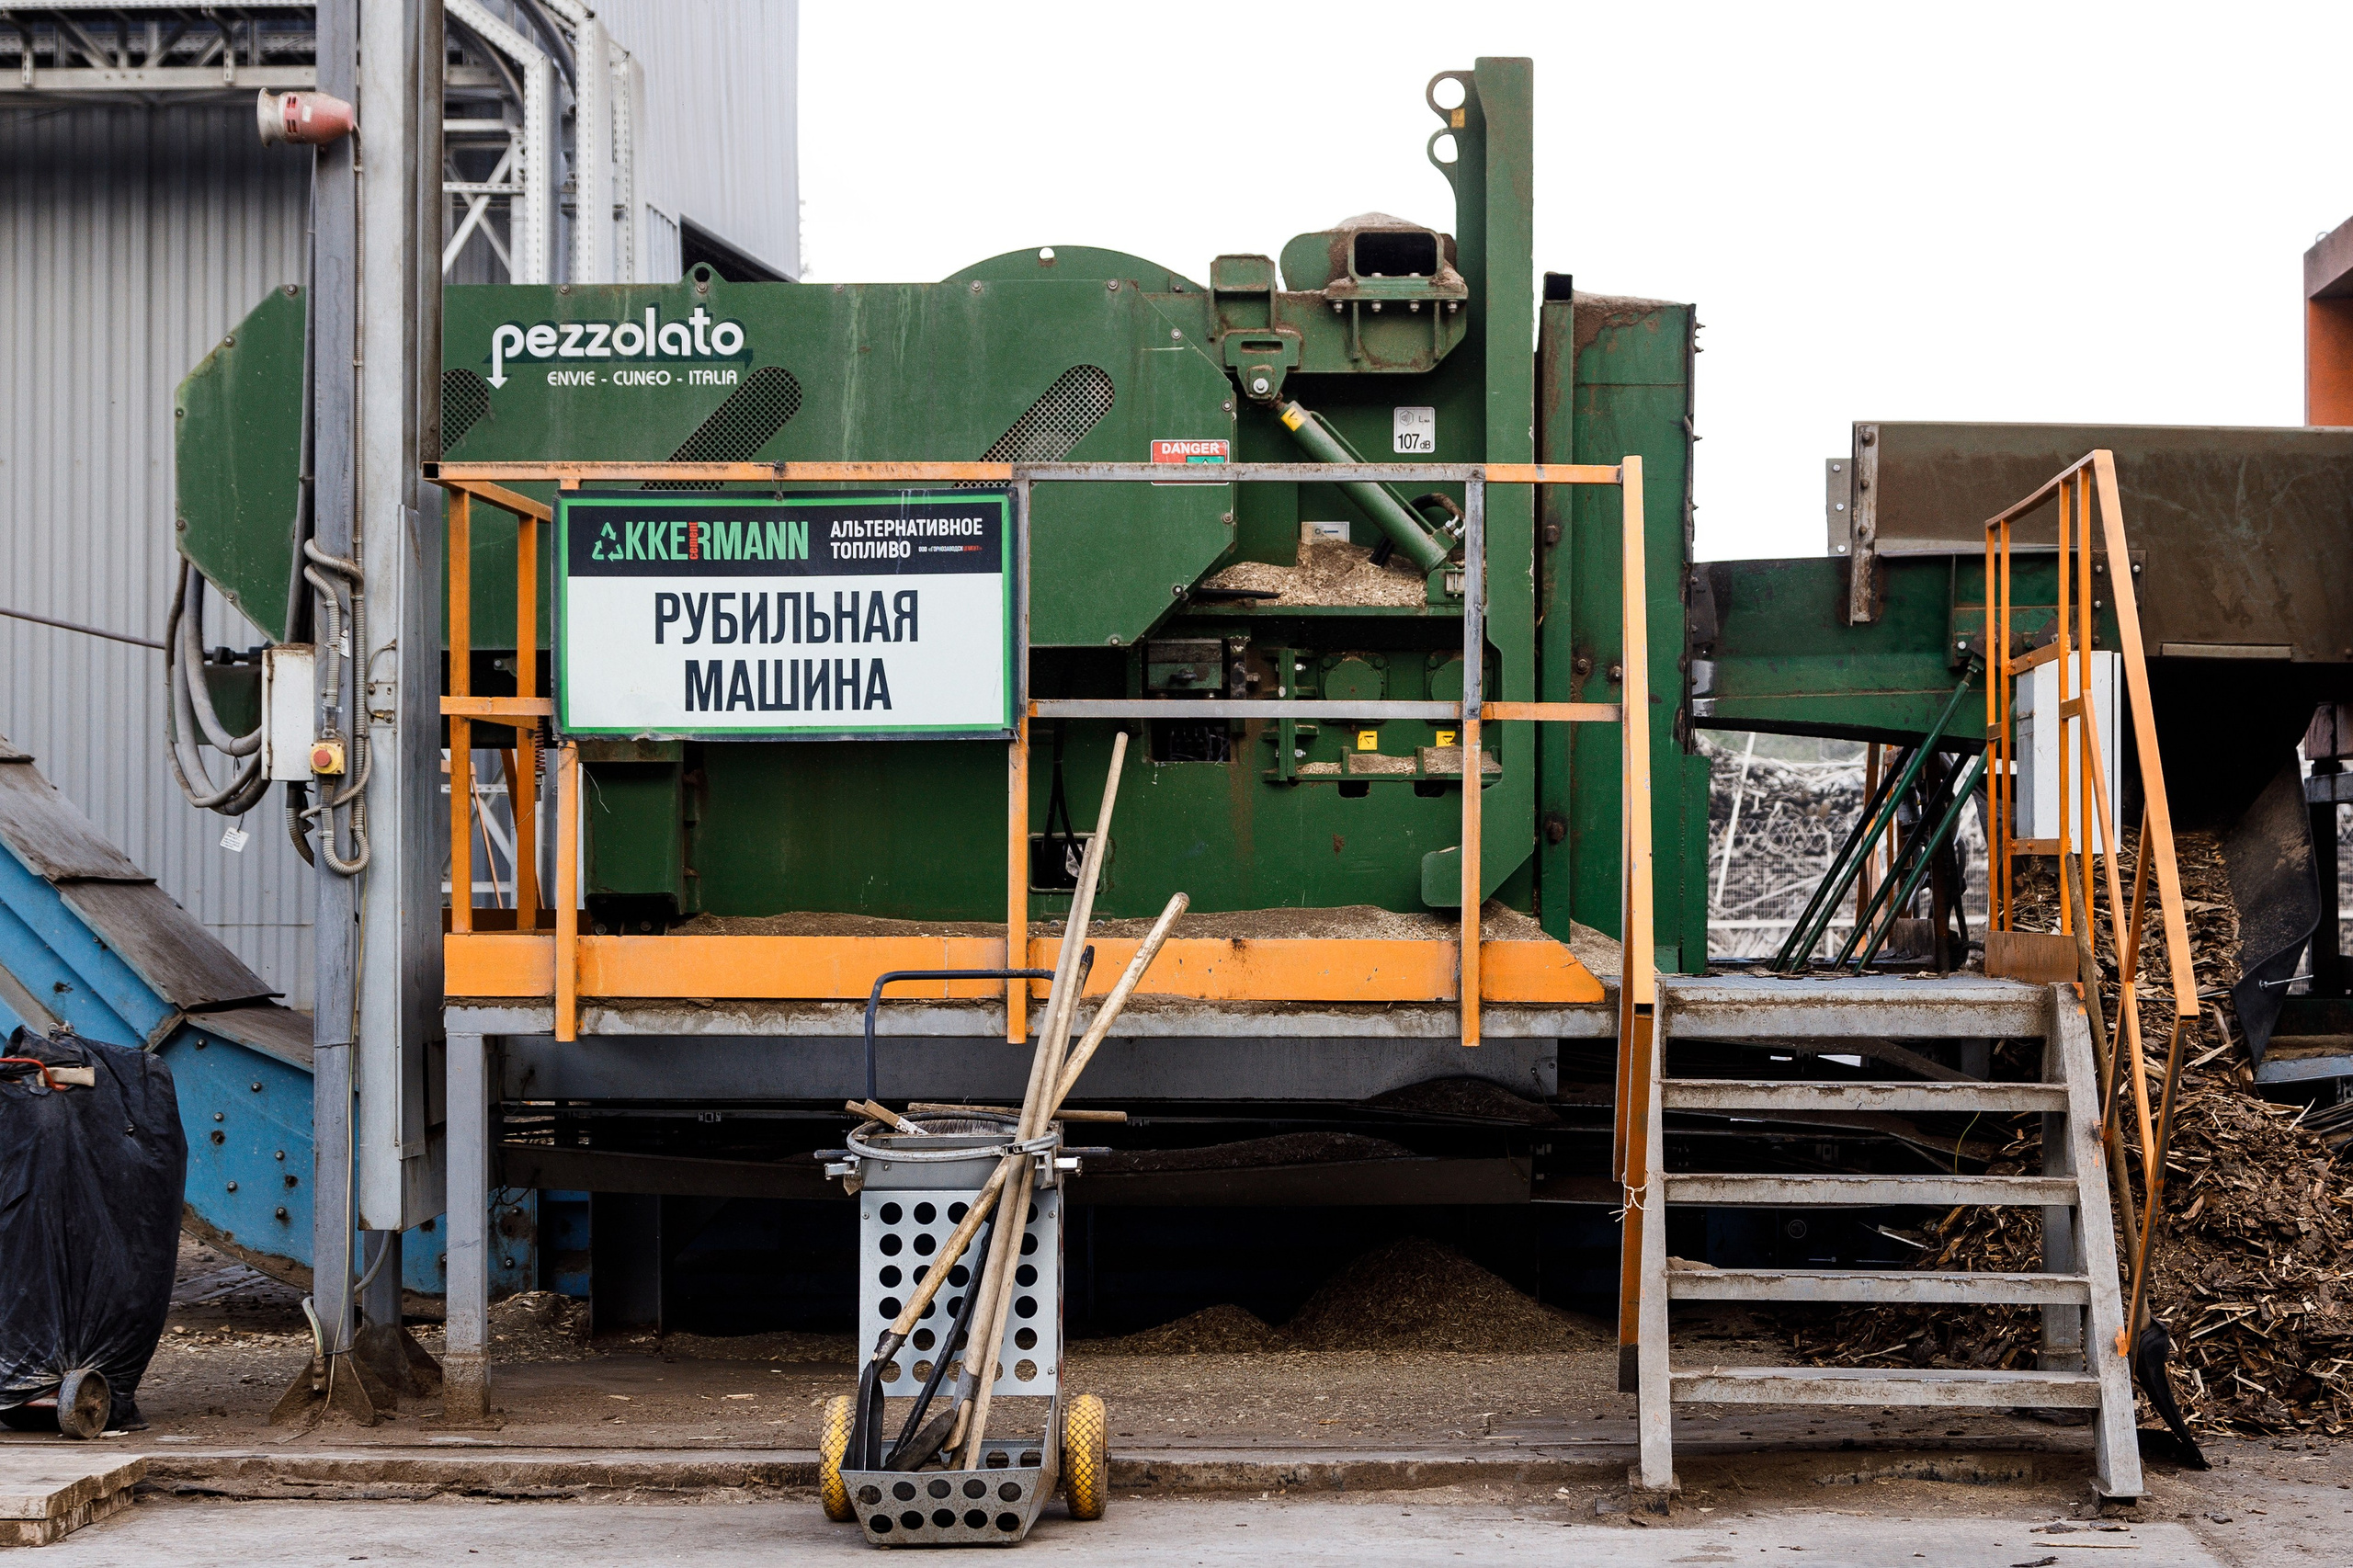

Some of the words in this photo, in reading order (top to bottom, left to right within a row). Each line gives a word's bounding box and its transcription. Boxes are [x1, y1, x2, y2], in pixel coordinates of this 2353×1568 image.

[486, 307, 745, 390] pezzolato
[547, 370, 595, 386] ENVIE
[612, 369, 671, 386] CUNEO
[688, 369, 737, 385] ITALIA
[1161, 442, 1220, 454] DANGER
[1398, 433, 1420, 449] 107
[1419, 439, 1431, 449] dB
[830, 517, 983, 538] АЛЬТЕРНАТИВНОЕ
[688, 521, 699, 560] cement
[830, 540, 911, 560] ТОПЛИВО
[654, 589, 919, 645] РУБИЛЬНАЯ
[684, 657, 892, 712] МАШИНА
